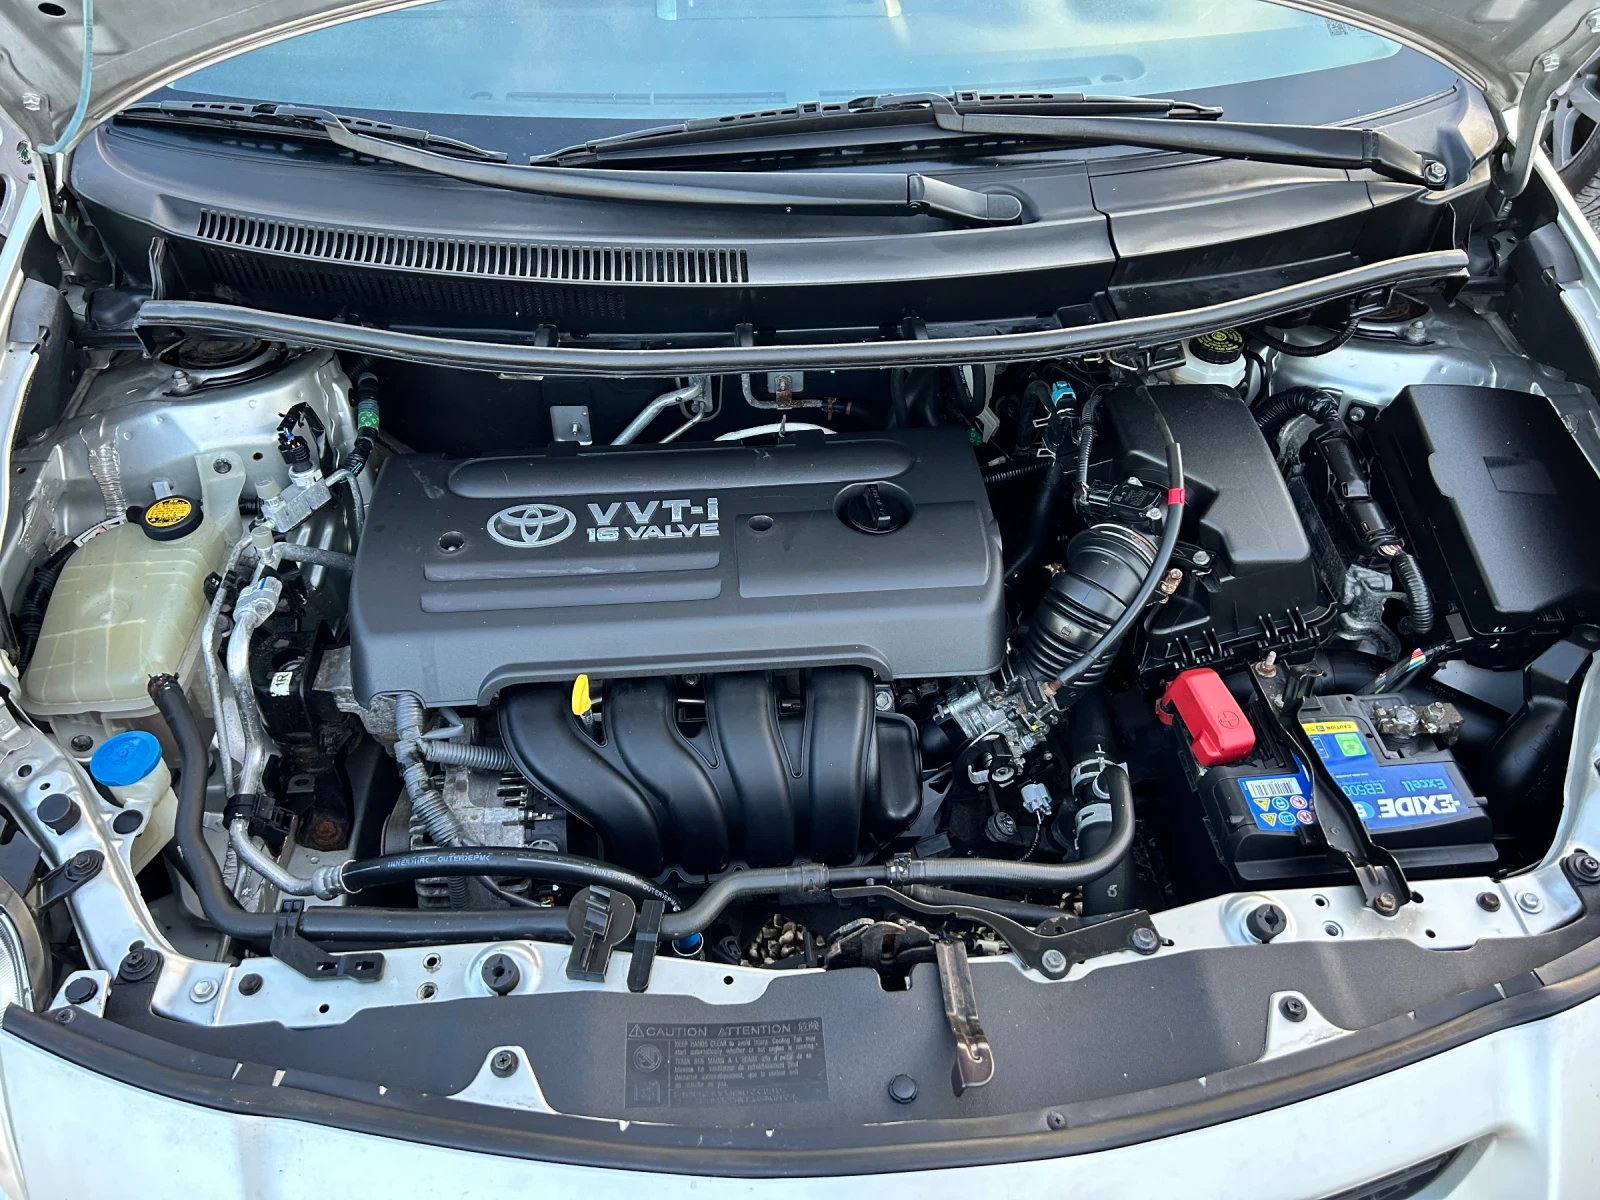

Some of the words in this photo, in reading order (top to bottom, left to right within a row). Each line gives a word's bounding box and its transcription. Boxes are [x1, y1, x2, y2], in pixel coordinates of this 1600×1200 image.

[587, 498, 719, 525] VVT-i
[587, 527, 619, 542] 16
[623, 523, 720, 540] VALVE
[1341, 783, 1385, 797] EB500
[1401, 778, 1447, 791] Excell
[1377, 794, 1460, 818] EXIDE
[646, 1026, 707, 1037] CAUTION
[718, 1024, 790, 1037] ATTENTION
